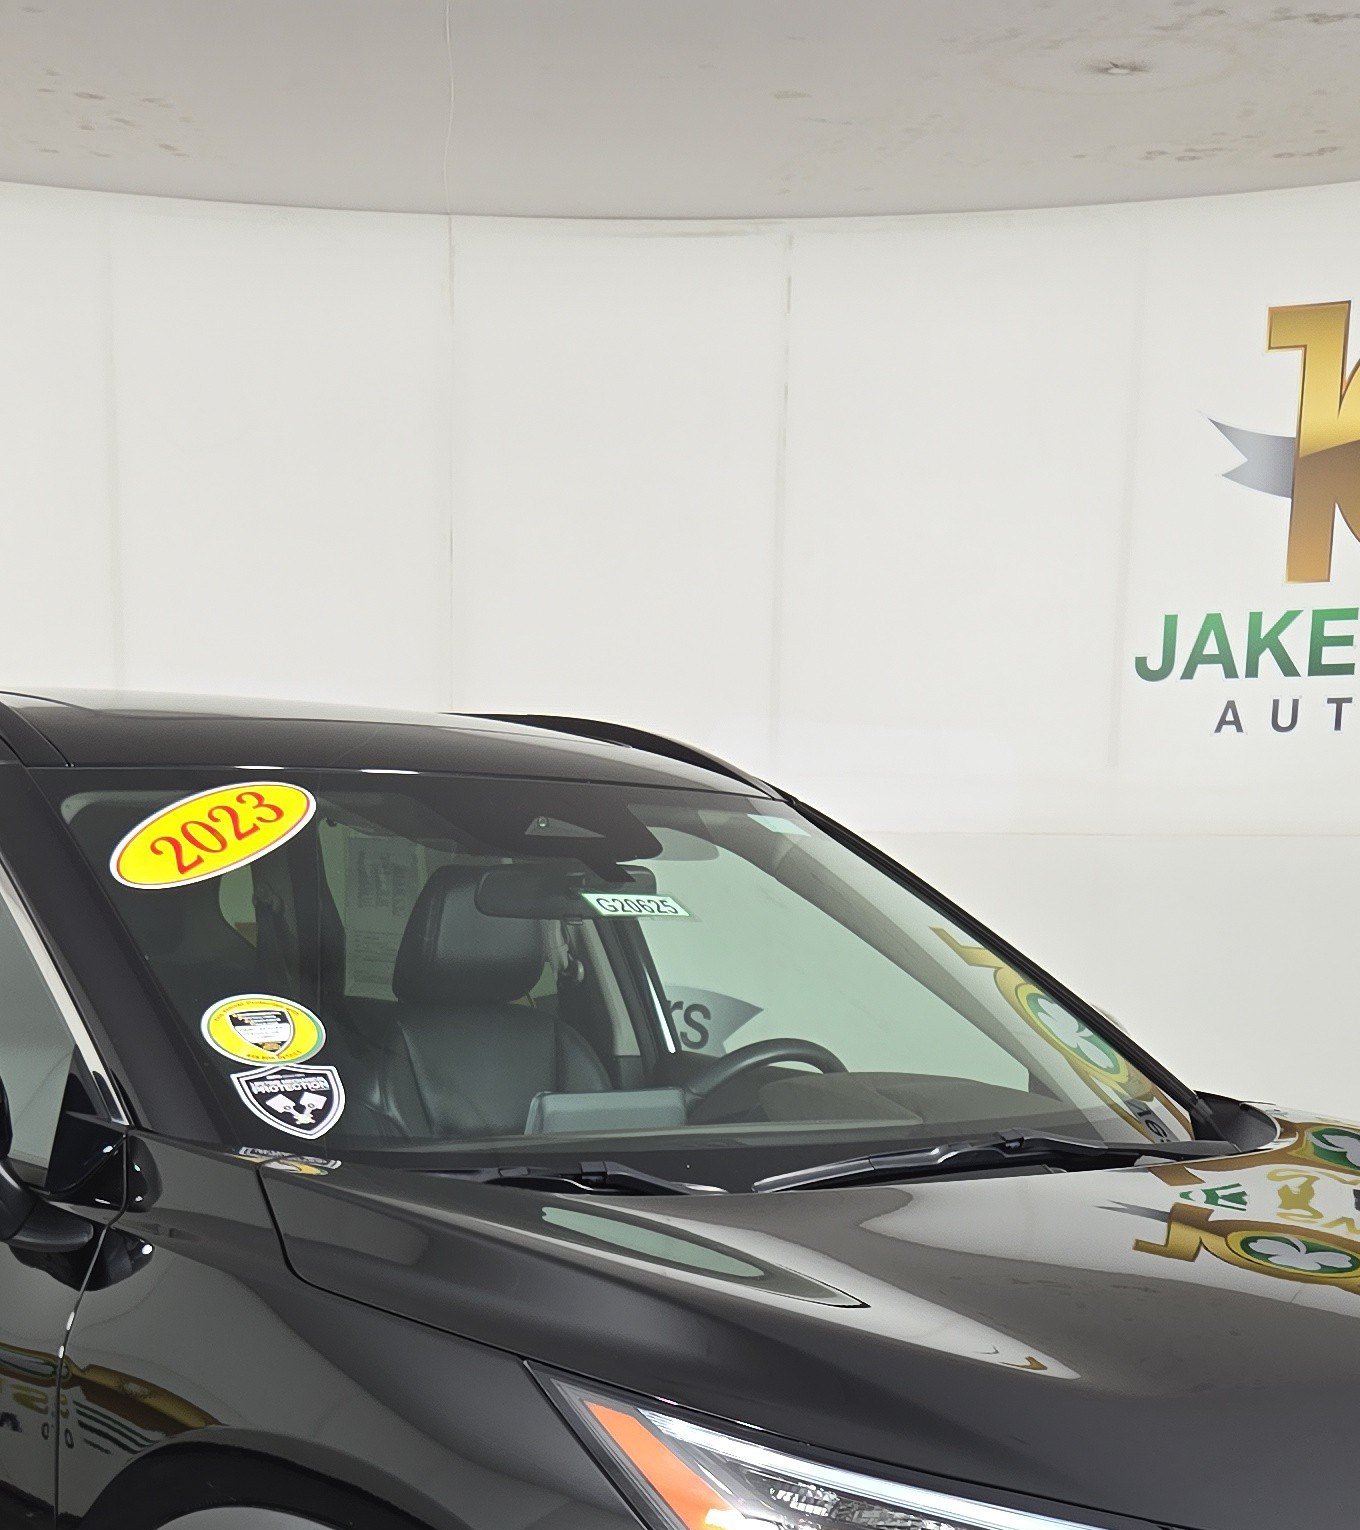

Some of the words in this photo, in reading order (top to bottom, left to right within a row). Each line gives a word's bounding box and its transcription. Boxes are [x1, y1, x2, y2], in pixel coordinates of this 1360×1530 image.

[1134, 607, 1360, 683] JAKE
[150, 791, 284, 875] 2023
[596, 898, 679, 914] G20625
